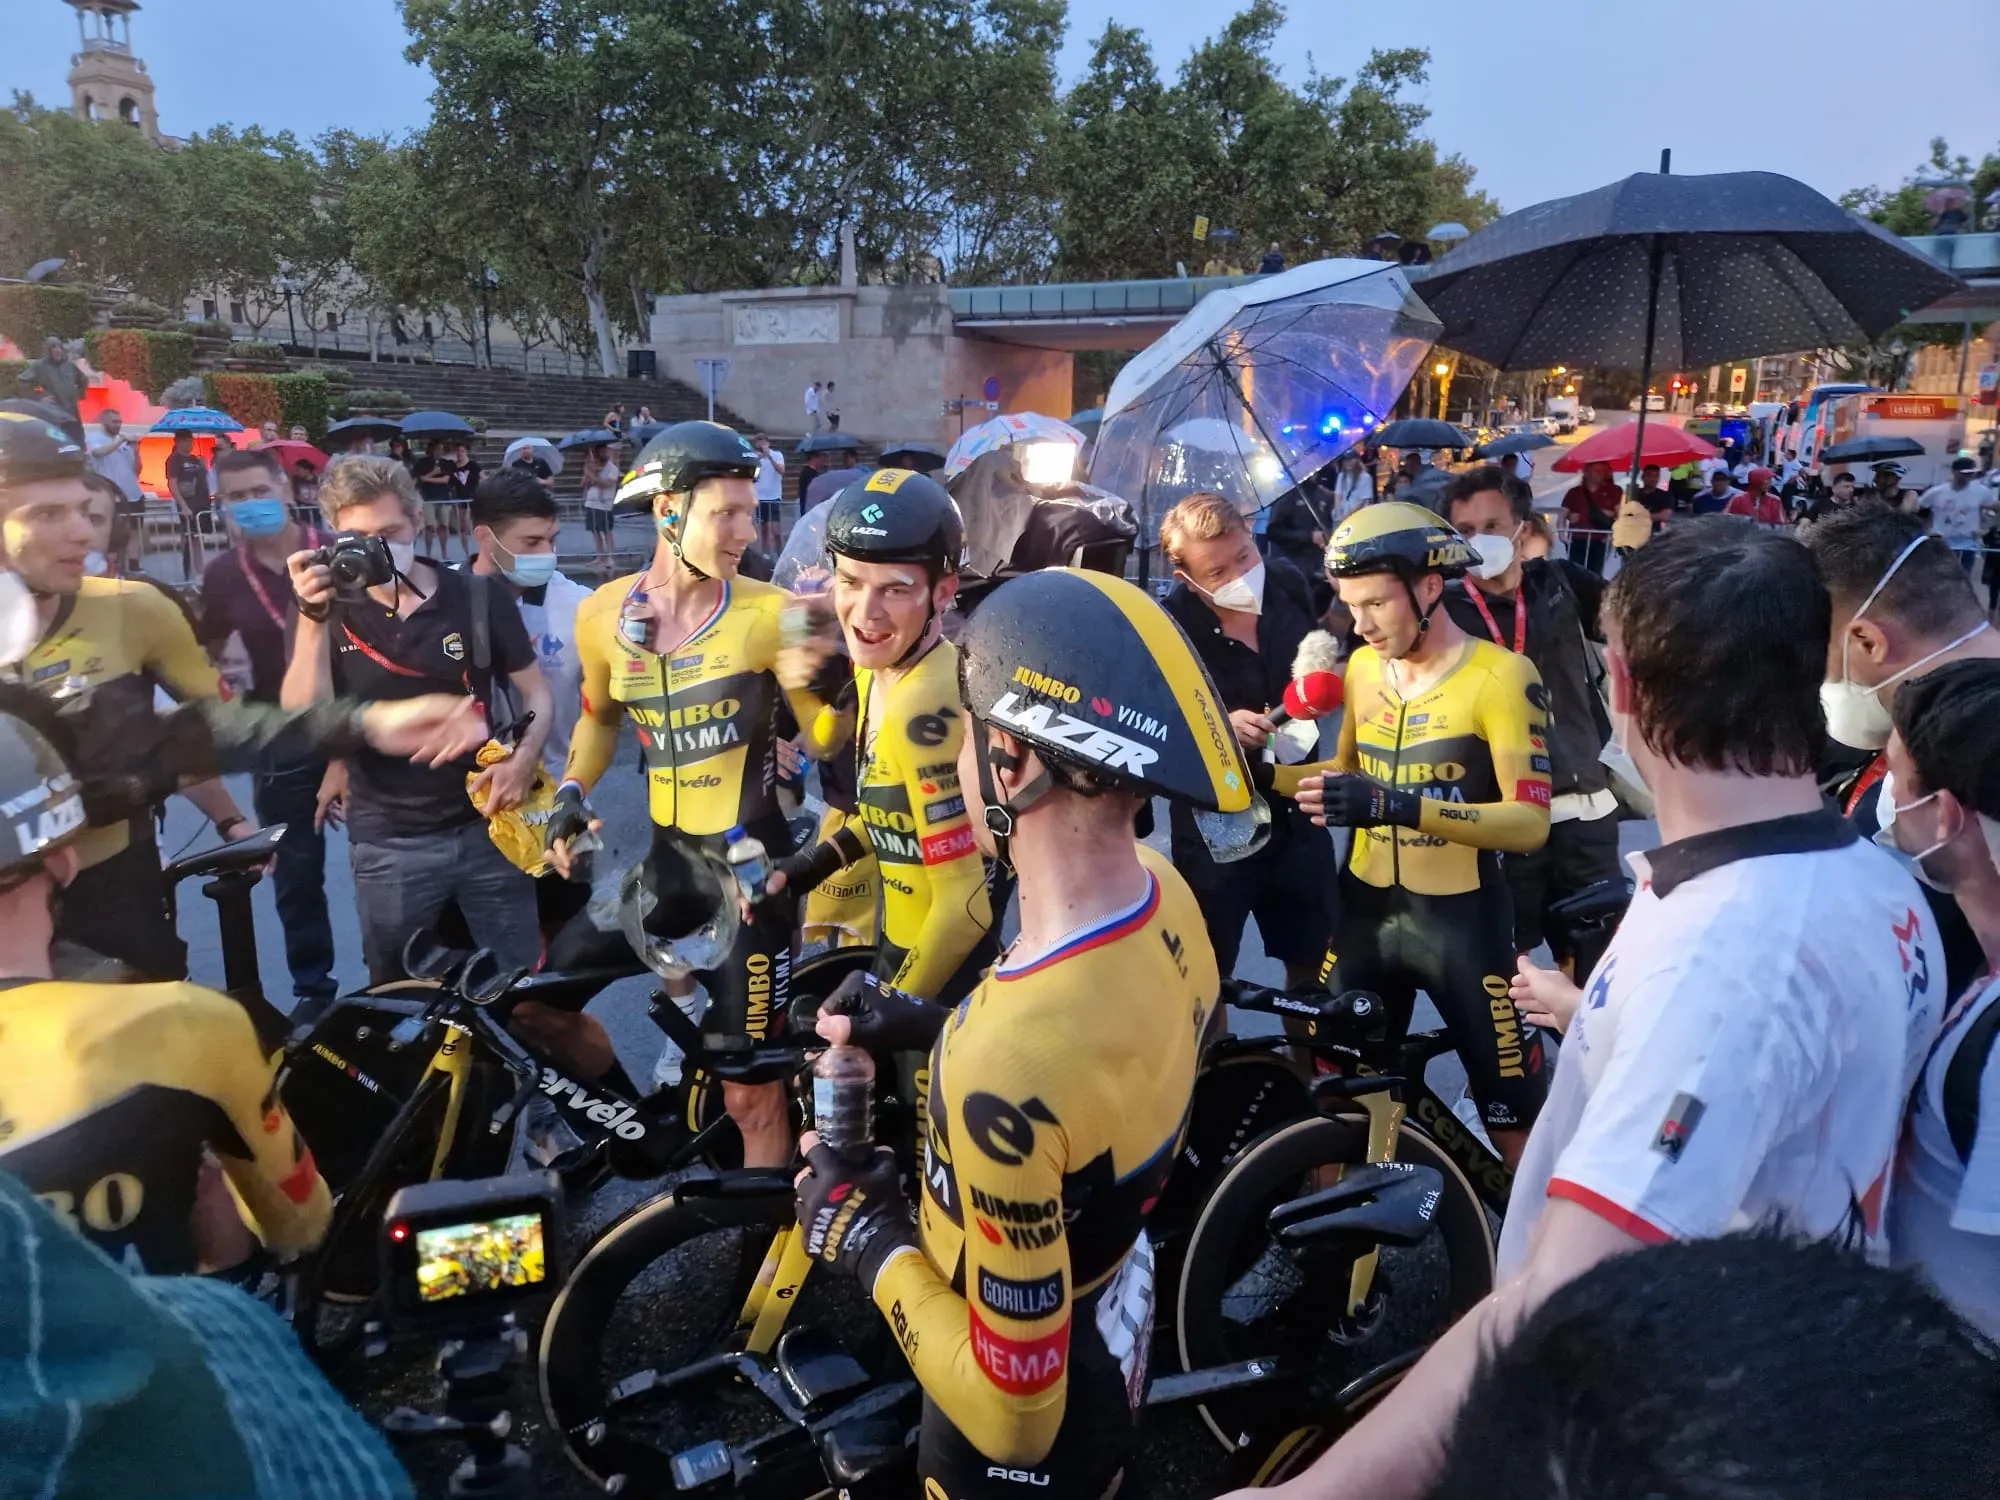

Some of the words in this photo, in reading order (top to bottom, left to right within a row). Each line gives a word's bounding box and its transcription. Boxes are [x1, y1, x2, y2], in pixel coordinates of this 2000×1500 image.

[851, 526, 888, 536] LAZER
[626, 699, 741, 729] UMBO
[1011, 666, 1081, 704] JUMBO
[1118, 705, 1168, 742] VISMA
[652, 722, 740, 753] VISMA
[989, 691, 1159, 778] LAZER
[1194, 689, 1231, 767] KINETICORE
[1440, 808, 1469, 820] AGU
[867, 827, 924, 858] ISMA
[744, 953, 770, 1041] JUMBO
[773, 946, 790, 1010] VISMA
[1482, 975, 1525, 1078] JUMBO
[312, 1043, 346, 1070] JUMBO
[357, 1072, 379, 1093] VISMA
[538, 1066, 647, 1141] ervélo
[1488, 1116, 1518, 1124] AGU
[969, 1184, 1059, 1225] JUMBO
[808, 1207, 838, 1254] VISMA
[1003, 1219, 1064, 1251] VISMA
[983, 1276, 1058, 1313] GORILLAS
[975, 1327, 1062, 1382] HEMA
[987, 1467, 1050, 1486] AGU
